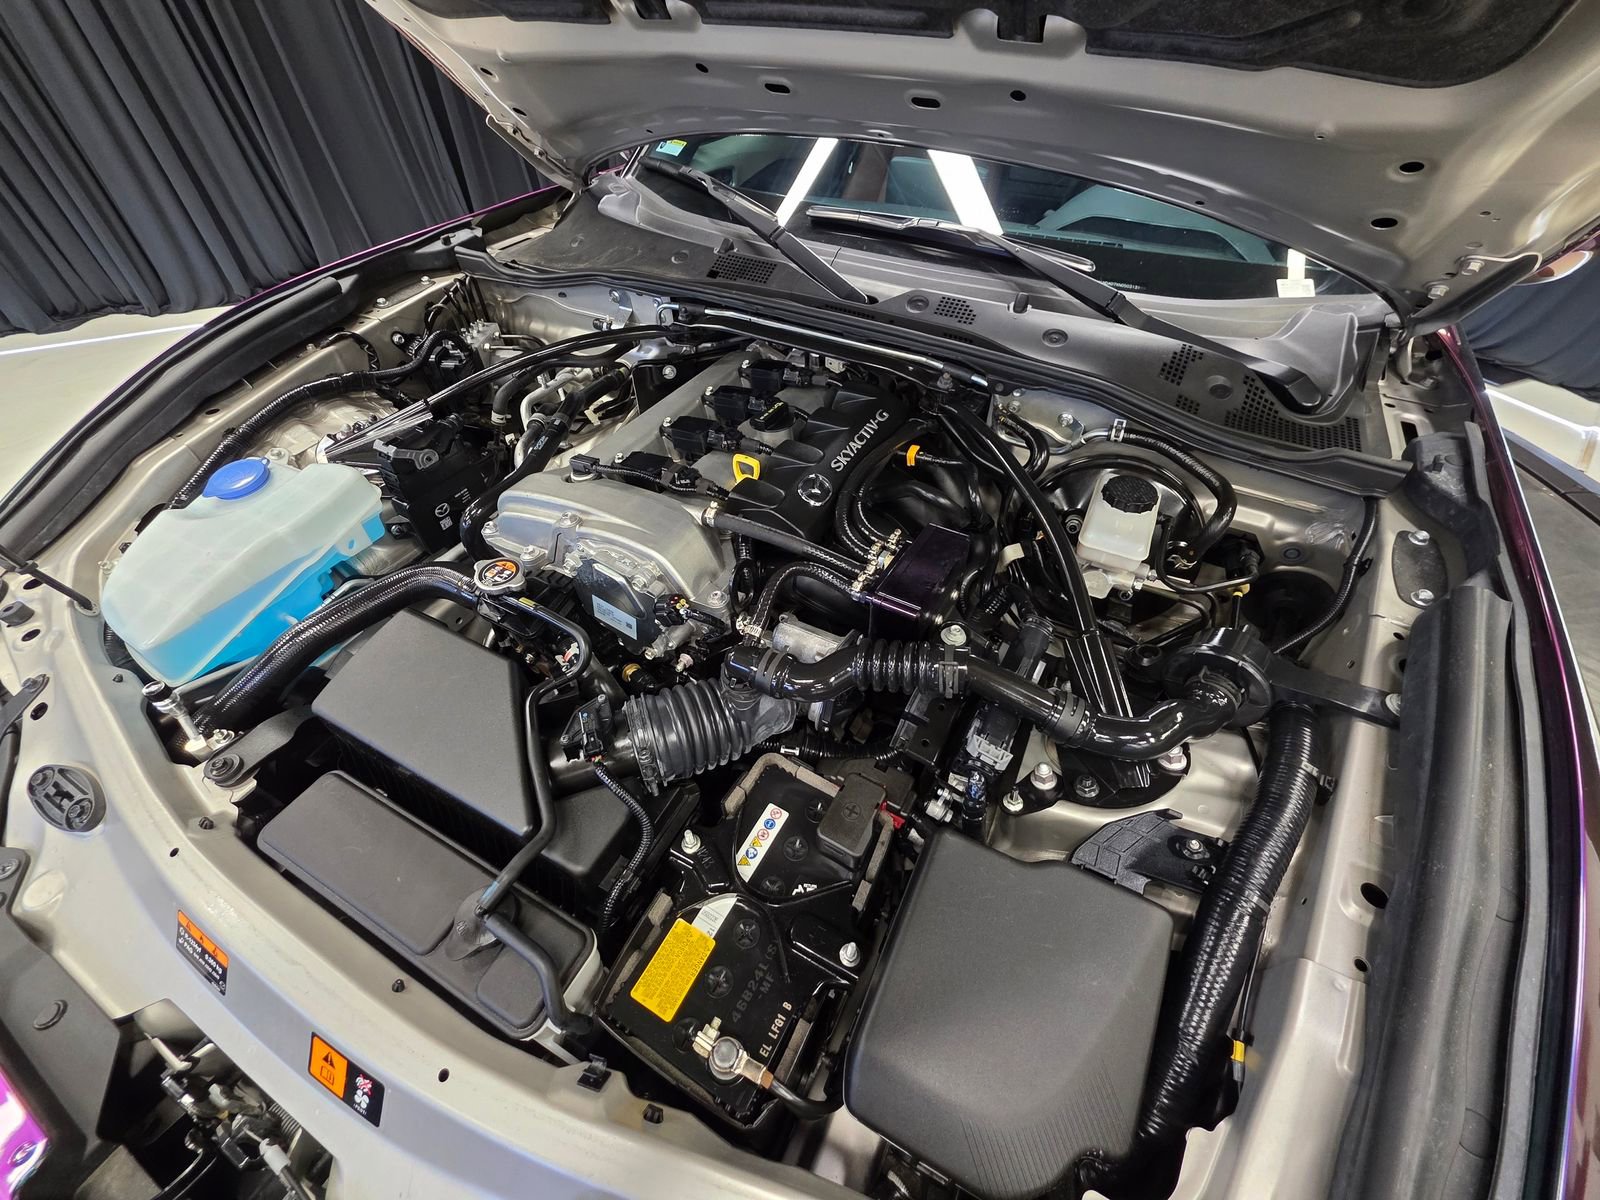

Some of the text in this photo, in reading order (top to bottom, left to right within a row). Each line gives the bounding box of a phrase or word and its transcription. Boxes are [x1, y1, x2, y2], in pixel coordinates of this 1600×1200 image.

[830, 408, 890, 472] SKYACTIV-G
[689, 950, 708, 977] DANGER
[759, 1043, 773, 1059] EL
[782, 1001, 793, 1012] B
